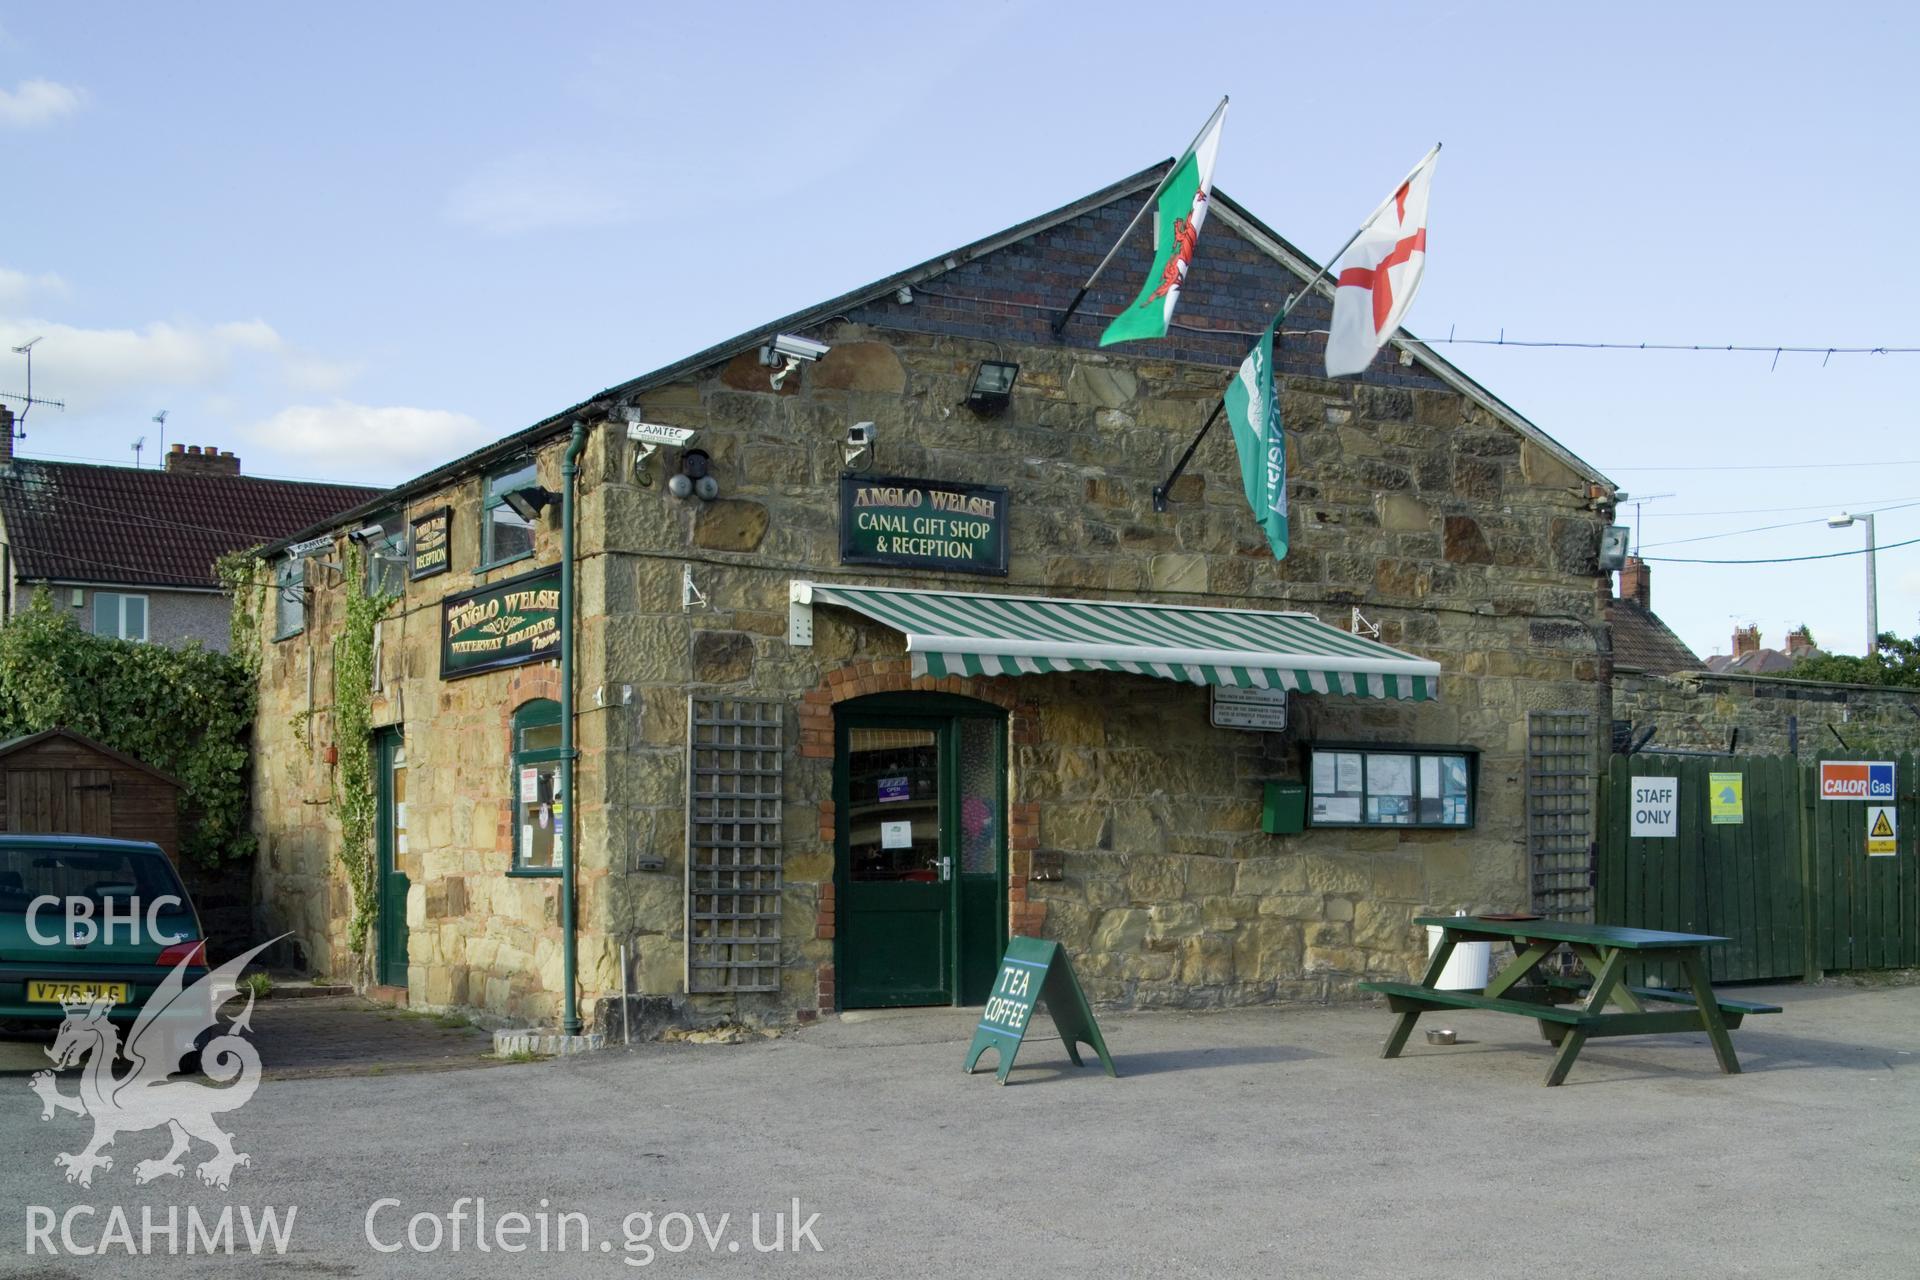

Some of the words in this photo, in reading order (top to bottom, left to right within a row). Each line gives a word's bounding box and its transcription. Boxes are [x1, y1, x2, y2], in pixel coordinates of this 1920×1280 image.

[636, 423, 683, 438] CAMTEC
[854, 488, 923, 507] ANGLO
[929, 490, 997, 519] WELSH
[858, 512, 909, 533] CANAL
[913, 517, 946, 536] GIFT
[950, 520, 990, 540] SHOP
[416, 547, 446, 570] RECEPTION
[876, 536, 888, 553] &
[892, 536, 973, 559] RECEPTION
[448, 599, 499, 639] ANGLO
[504, 590, 560, 613] WELSH
[452, 637, 503, 654] WATERWAY
[506, 617, 555, 647] HOLIDAYS
[1636, 789, 1672, 803] STAFF
[1824, 780, 1868, 797] CALOR
[1871, 780, 1891, 794] Gas
[1636, 810, 1671, 824] ONLY
[1000, 967, 1030, 997] TEA
[984, 996, 1028, 1028] COFFEE
